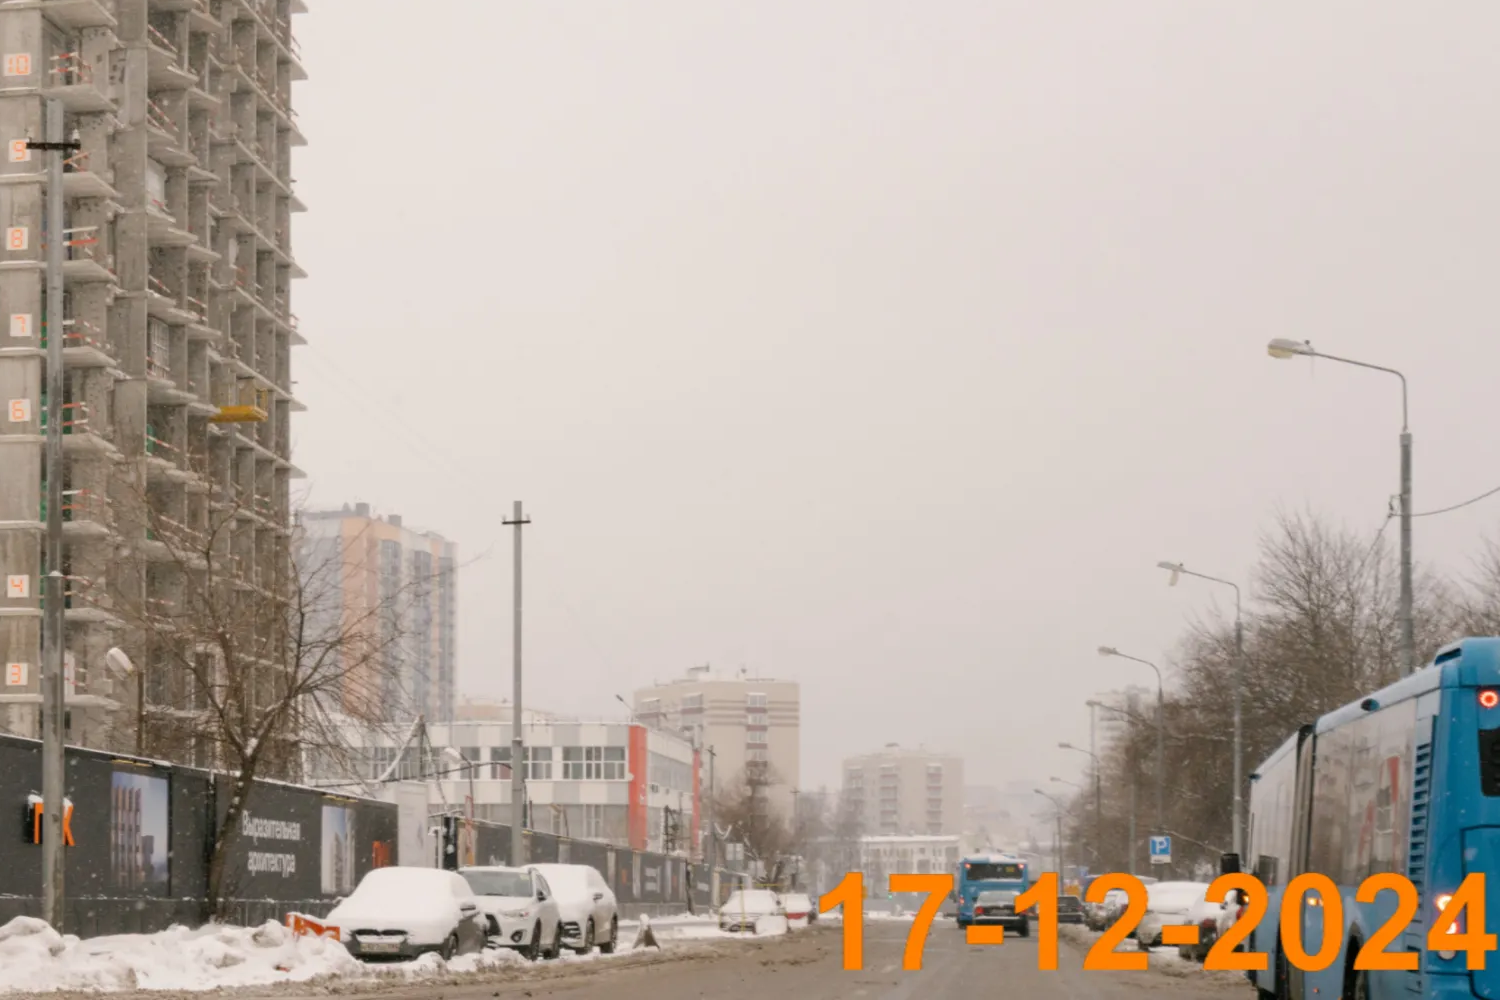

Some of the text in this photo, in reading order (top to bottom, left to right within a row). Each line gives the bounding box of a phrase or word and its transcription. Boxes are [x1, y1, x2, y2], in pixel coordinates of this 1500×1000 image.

[9, 55, 29, 75] 10
[13, 141, 26, 160] 9
[11, 229, 23, 248] 8
[14, 316, 26, 333] 7
[11, 401, 24, 420] 6
[10, 579, 24, 593] 4
[11, 664, 21, 684] 3
[1156, 838, 1168, 854] P
[248, 851, 296, 878] архитектура
